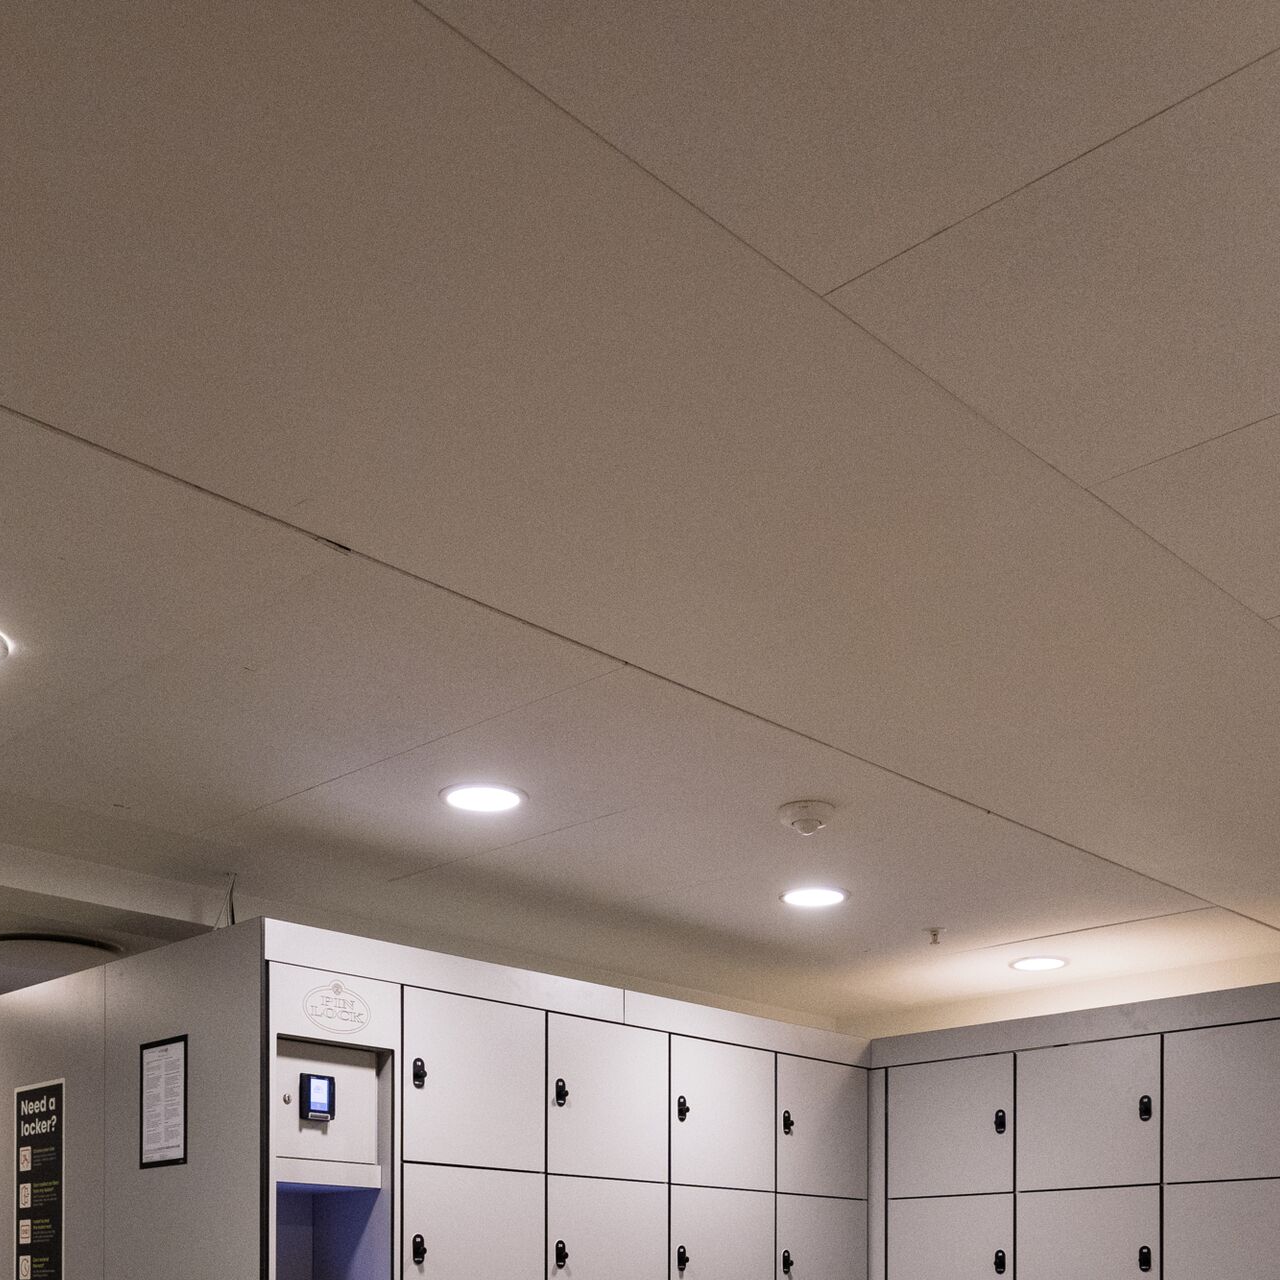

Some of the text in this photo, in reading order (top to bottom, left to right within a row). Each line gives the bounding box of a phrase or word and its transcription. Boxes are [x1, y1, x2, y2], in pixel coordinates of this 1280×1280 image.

[320, 995, 355, 1010] PIN
[311, 1005, 364, 1023] LOCK
[20, 1095, 56, 1116] Need a
[21, 1115, 57, 1137] locker?
